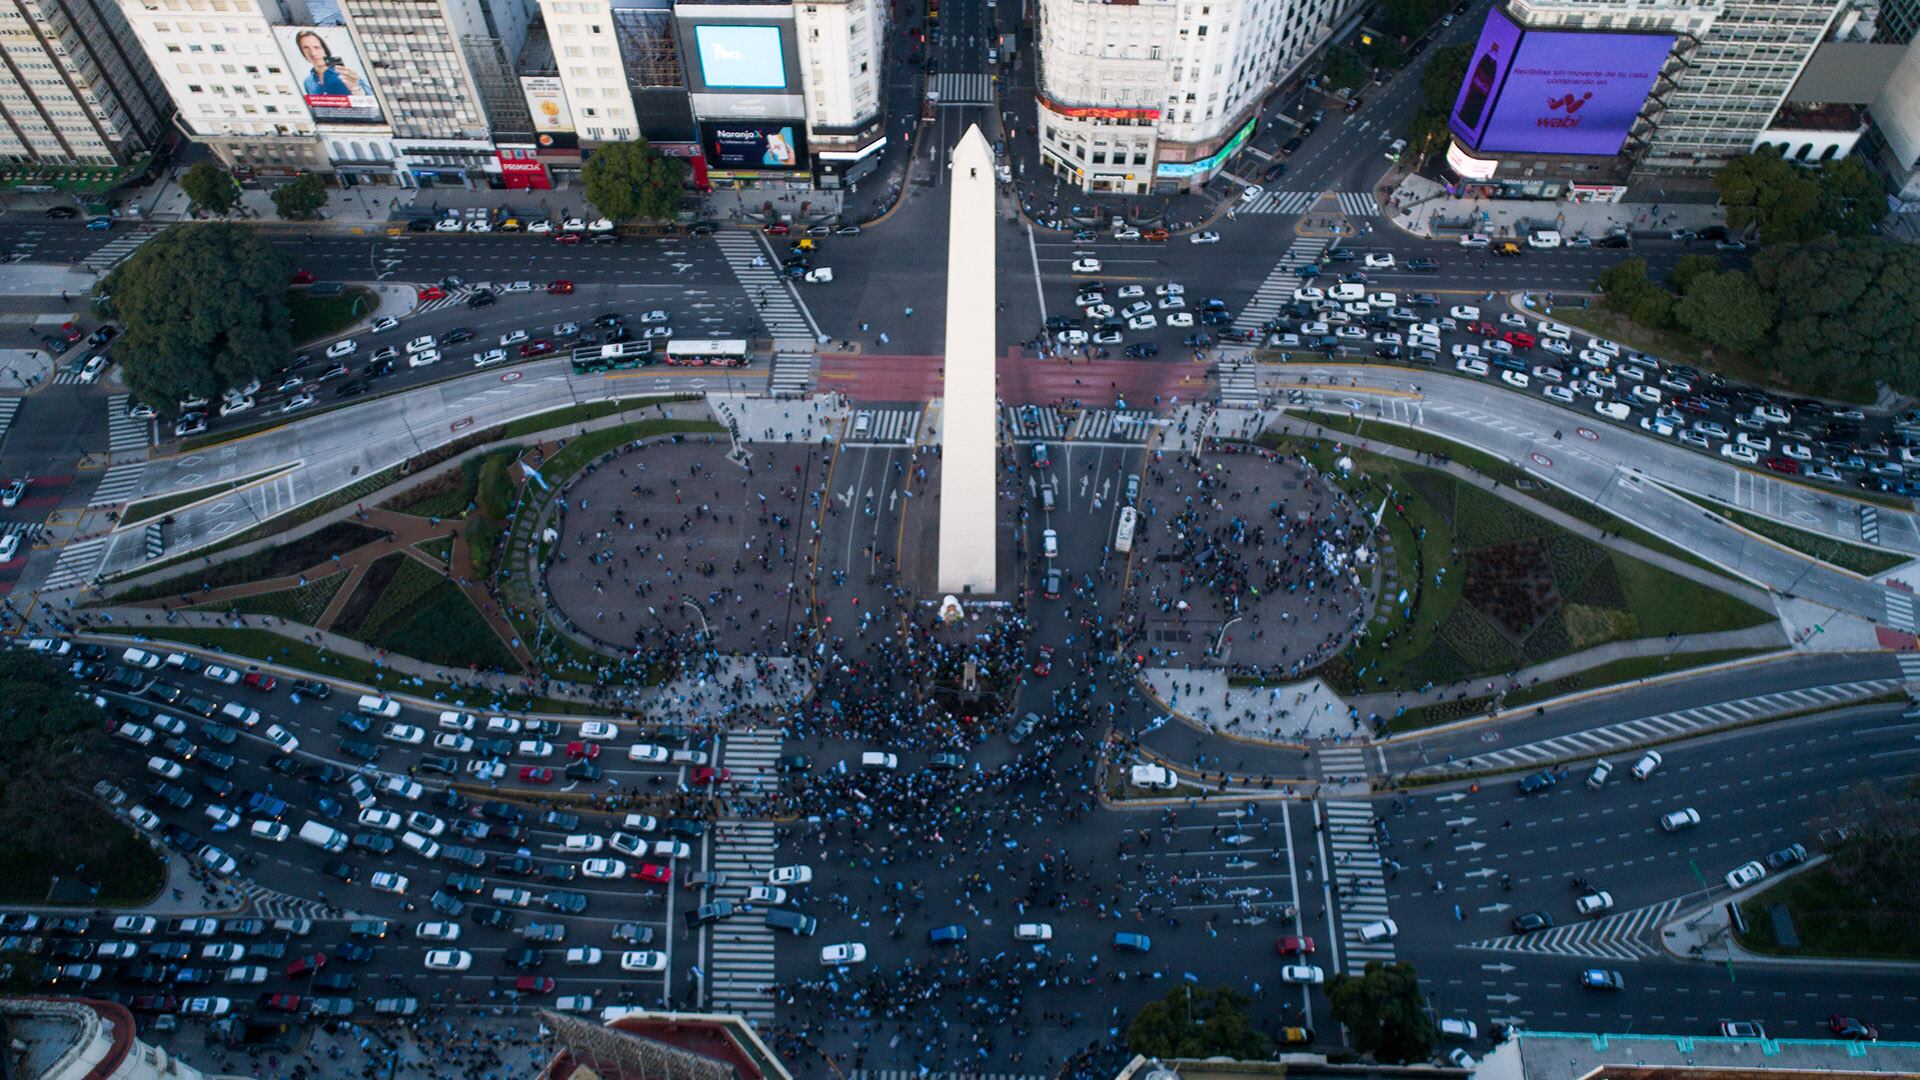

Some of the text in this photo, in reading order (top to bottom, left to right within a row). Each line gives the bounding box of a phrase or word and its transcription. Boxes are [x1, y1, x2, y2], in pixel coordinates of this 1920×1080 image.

[1536, 114, 1583, 128] wabi
[717, 129, 754, 139] Naranja
[503, 163, 541, 171] PRIMICIA
